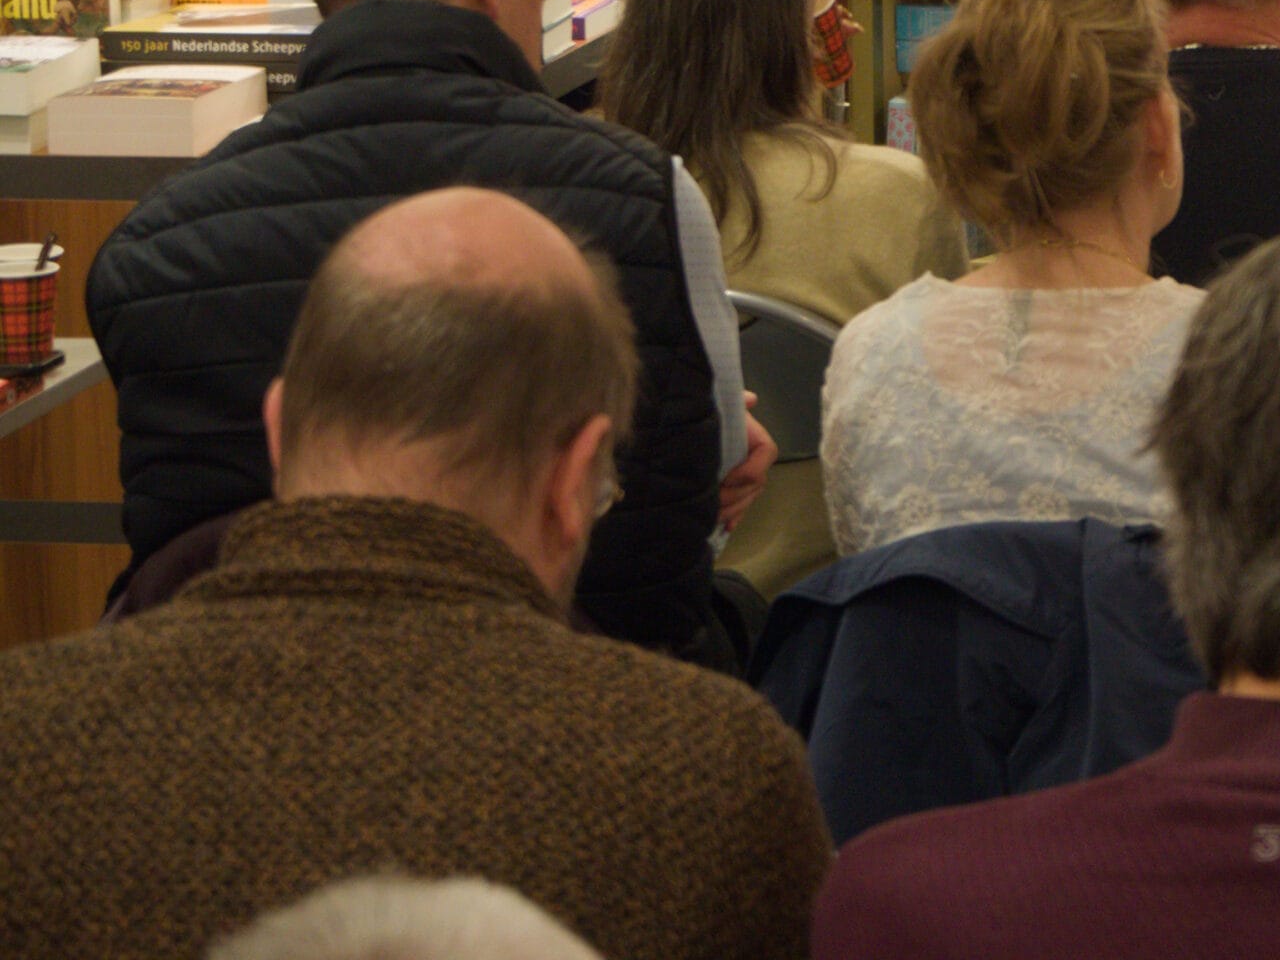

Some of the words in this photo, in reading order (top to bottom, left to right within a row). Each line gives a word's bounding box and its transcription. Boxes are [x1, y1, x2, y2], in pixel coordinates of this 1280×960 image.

[121, 40, 141, 53] 150
[143, 40, 169, 54] jaar
[172, 39, 249, 53] Nederlandse
